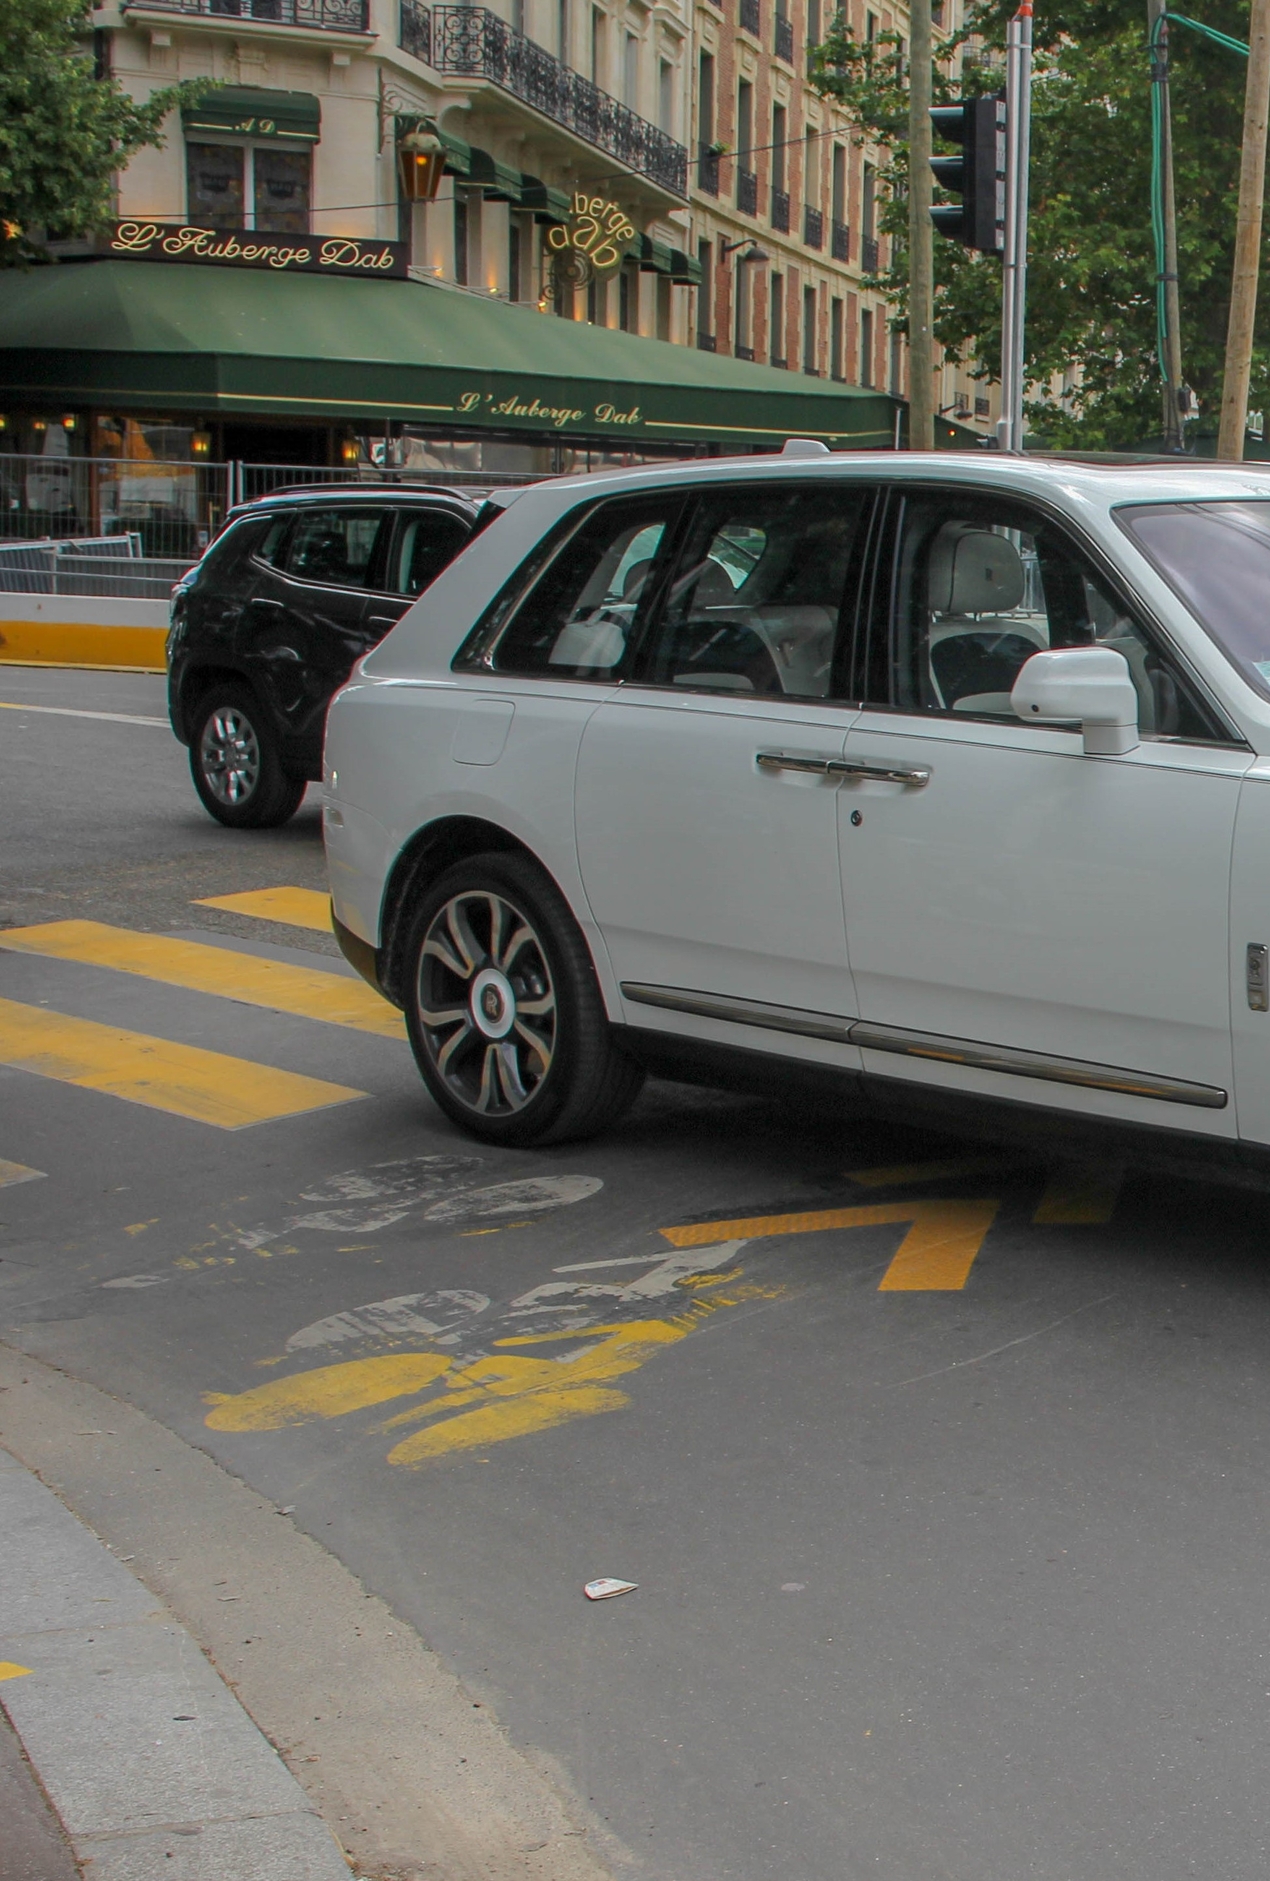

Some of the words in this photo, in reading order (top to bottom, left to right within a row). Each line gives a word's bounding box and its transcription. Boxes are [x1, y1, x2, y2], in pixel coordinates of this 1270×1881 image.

[569, 191, 635, 241] berge
[111, 222, 312, 268] L'Auberge
[319, 238, 394, 269] Dab
[595, 403, 643, 425] Dab
